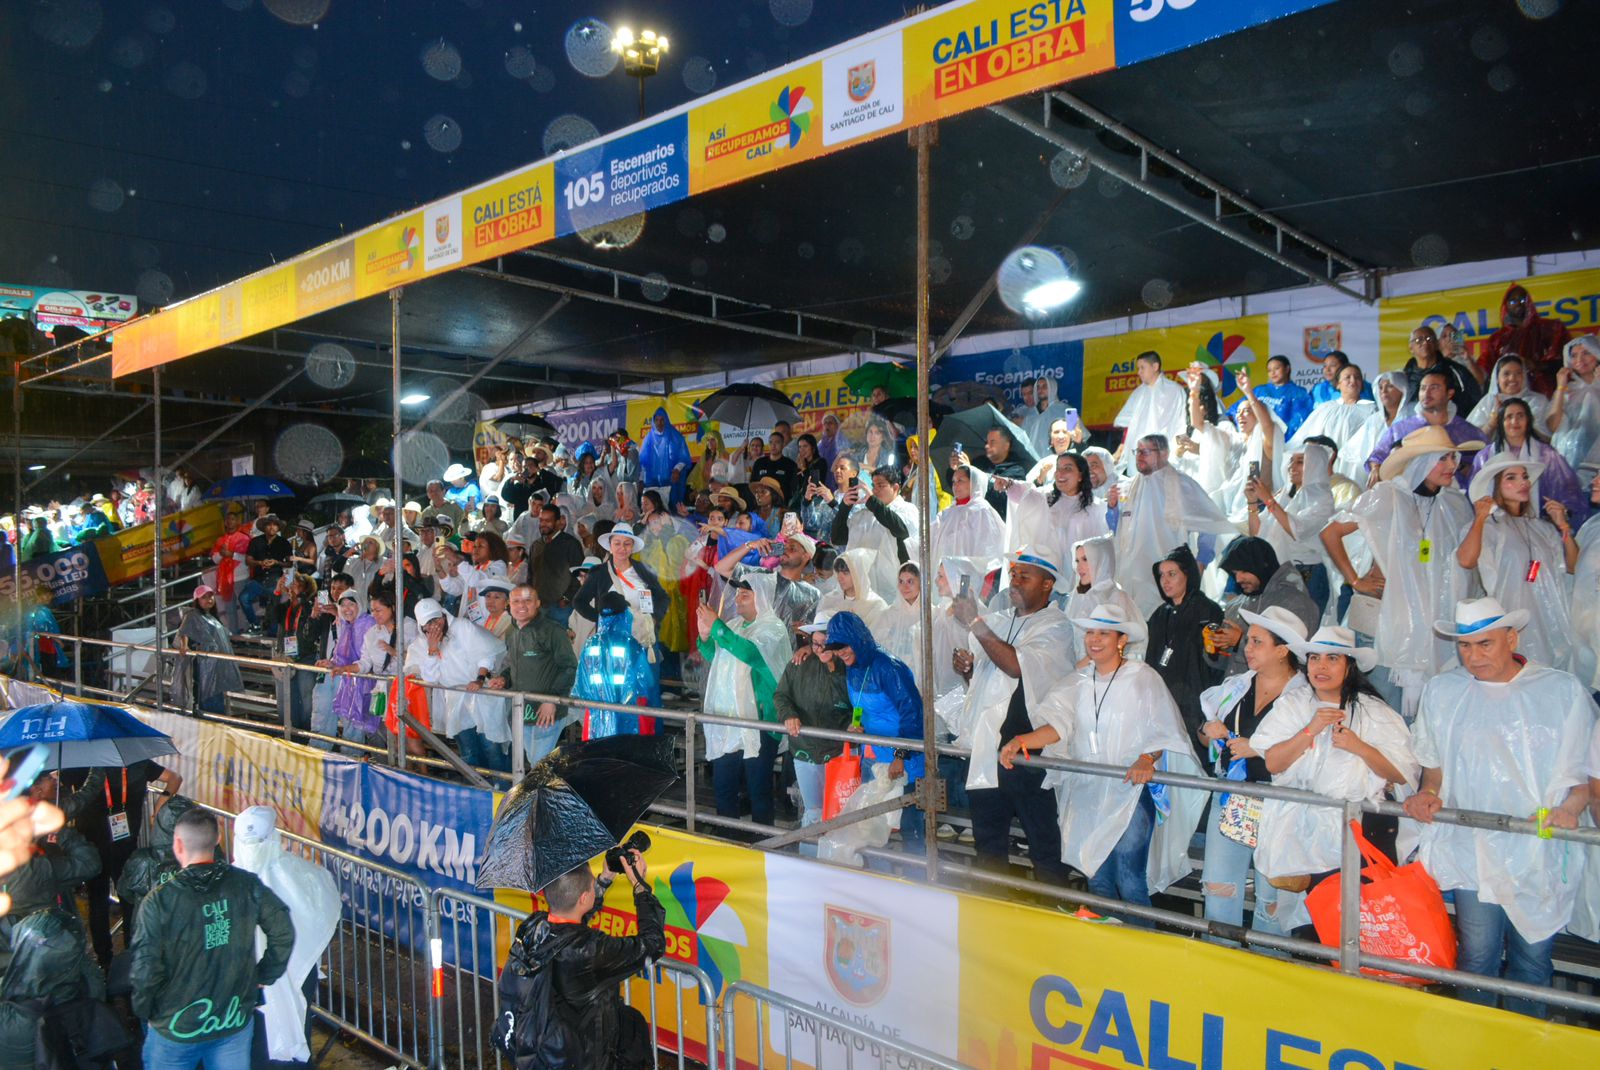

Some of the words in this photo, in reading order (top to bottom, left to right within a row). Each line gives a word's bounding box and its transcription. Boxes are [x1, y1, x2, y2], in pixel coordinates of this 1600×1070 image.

[933, 20, 998, 64] CALI
[940, 61, 977, 94] EN
[987, 26, 1079, 78] OBRA
[709, 123, 727, 142] ASÍ
[830, 114, 865, 131] SANTIAGO
[867, 111, 877, 120] DE
[879, 104, 895, 115] CALI
[707, 122, 788, 158] RECUPERAMOS
[746, 144, 772, 160] CALI
[610, 143, 675, 176] Escenarios
[564, 171, 605, 210] 105
[610, 162, 668, 192] deportivos
[610, 173, 680, 206] recuperados
[474, 199, 504, 225] CALI
[509, 182, 542, 213] ESTÁ
[477, 225, 494, 245] EN
[499, 213, 540, 238] OBRA
[975, 366, 1065, 385] Escenarios
[1111, 358, 1136, 375] ASÍ
[791, 388, 830, 411] CALI
[65, 570, 88, 583] LED
[21, 731, 65, 740] HOELS
[417, 821, 475, 885] KM
[203, 899, 228, 917] CALI
[169, 996, 246, 1038] Cali
[1029, 974, 1224, 1070] CALI
